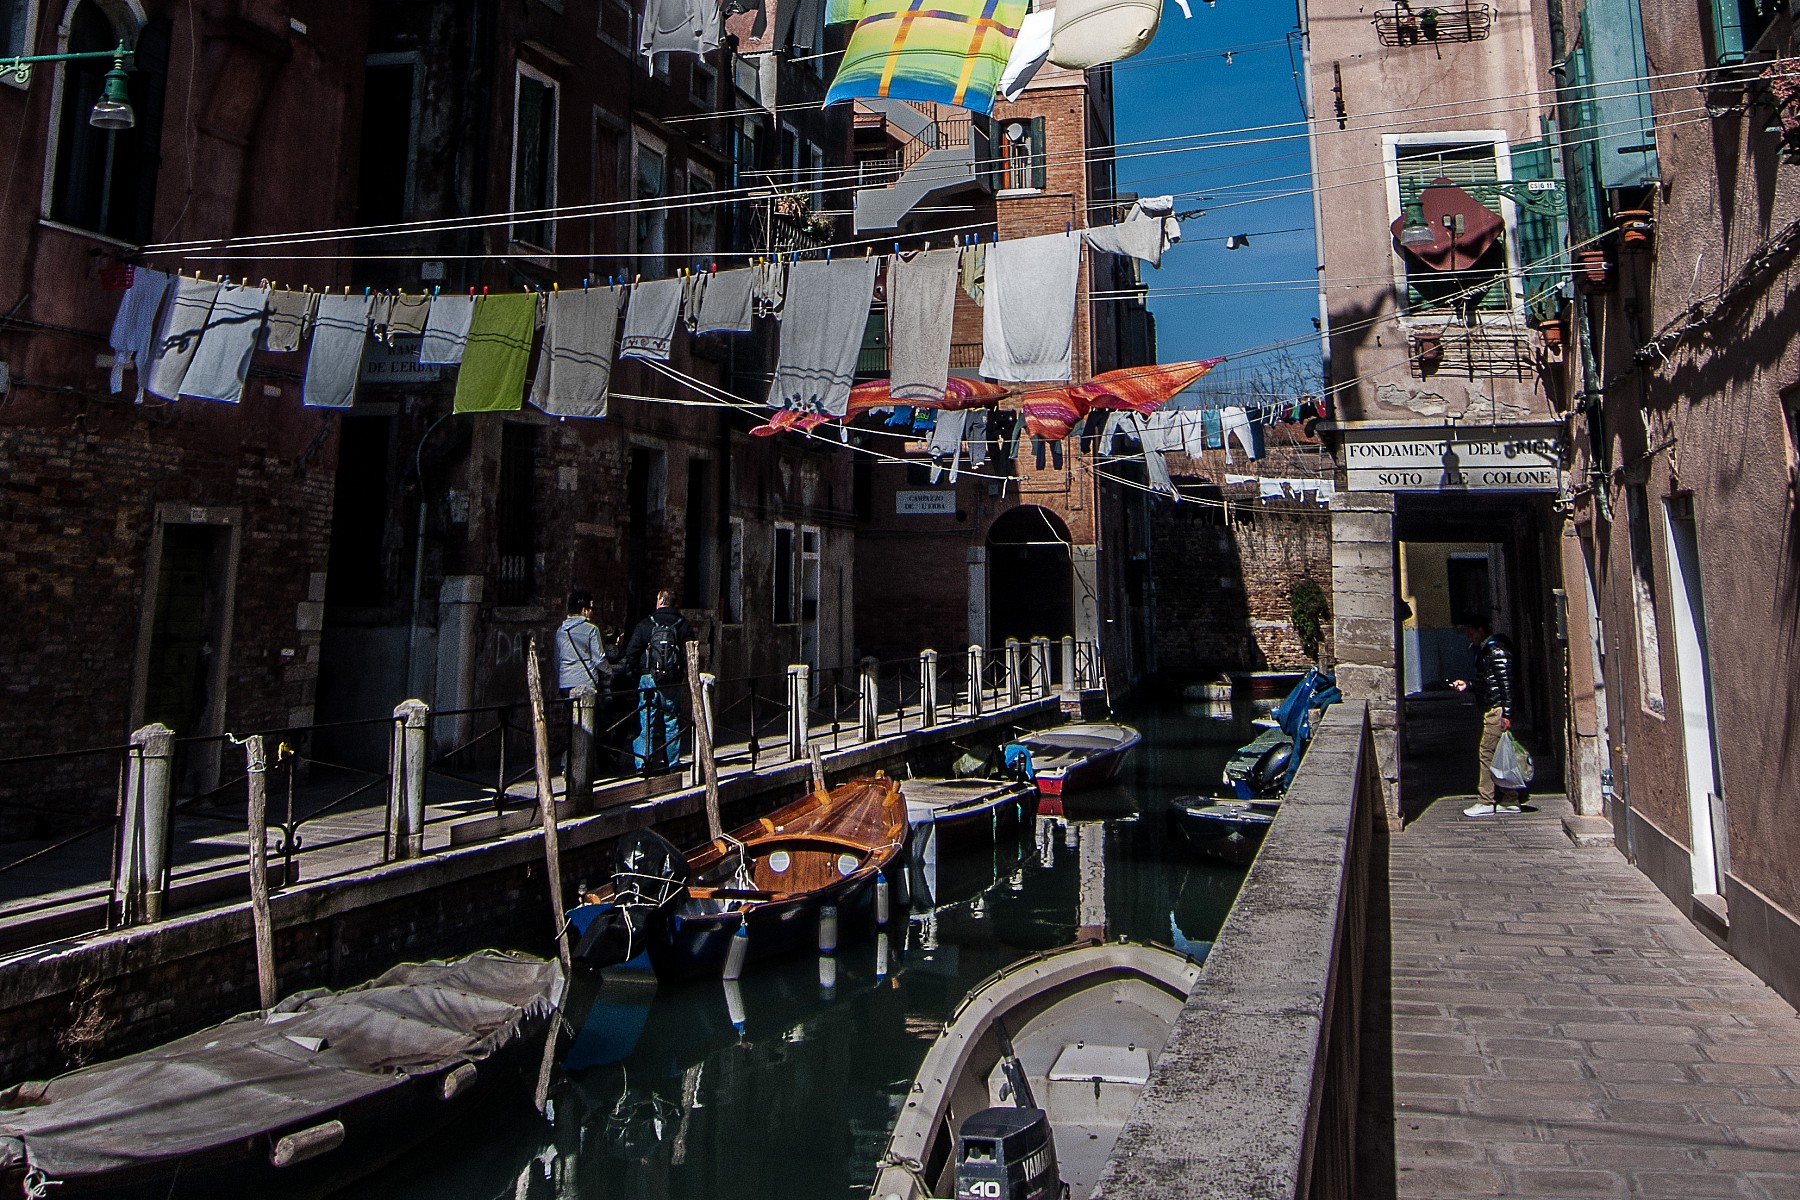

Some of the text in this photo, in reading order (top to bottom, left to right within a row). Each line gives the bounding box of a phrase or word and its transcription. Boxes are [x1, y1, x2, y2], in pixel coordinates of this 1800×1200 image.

[368, 362, 385, 373] DE
[1349, 443, 1454, 457] FONDAMENTA
[1468, 442, 1501, 456] DEL
[1378, 471, 1550, 485] SOTO LE COLONE
[1022, 1146, 1051, 1181] YAMAH
[969, 1181, 1001, 1198] 40
